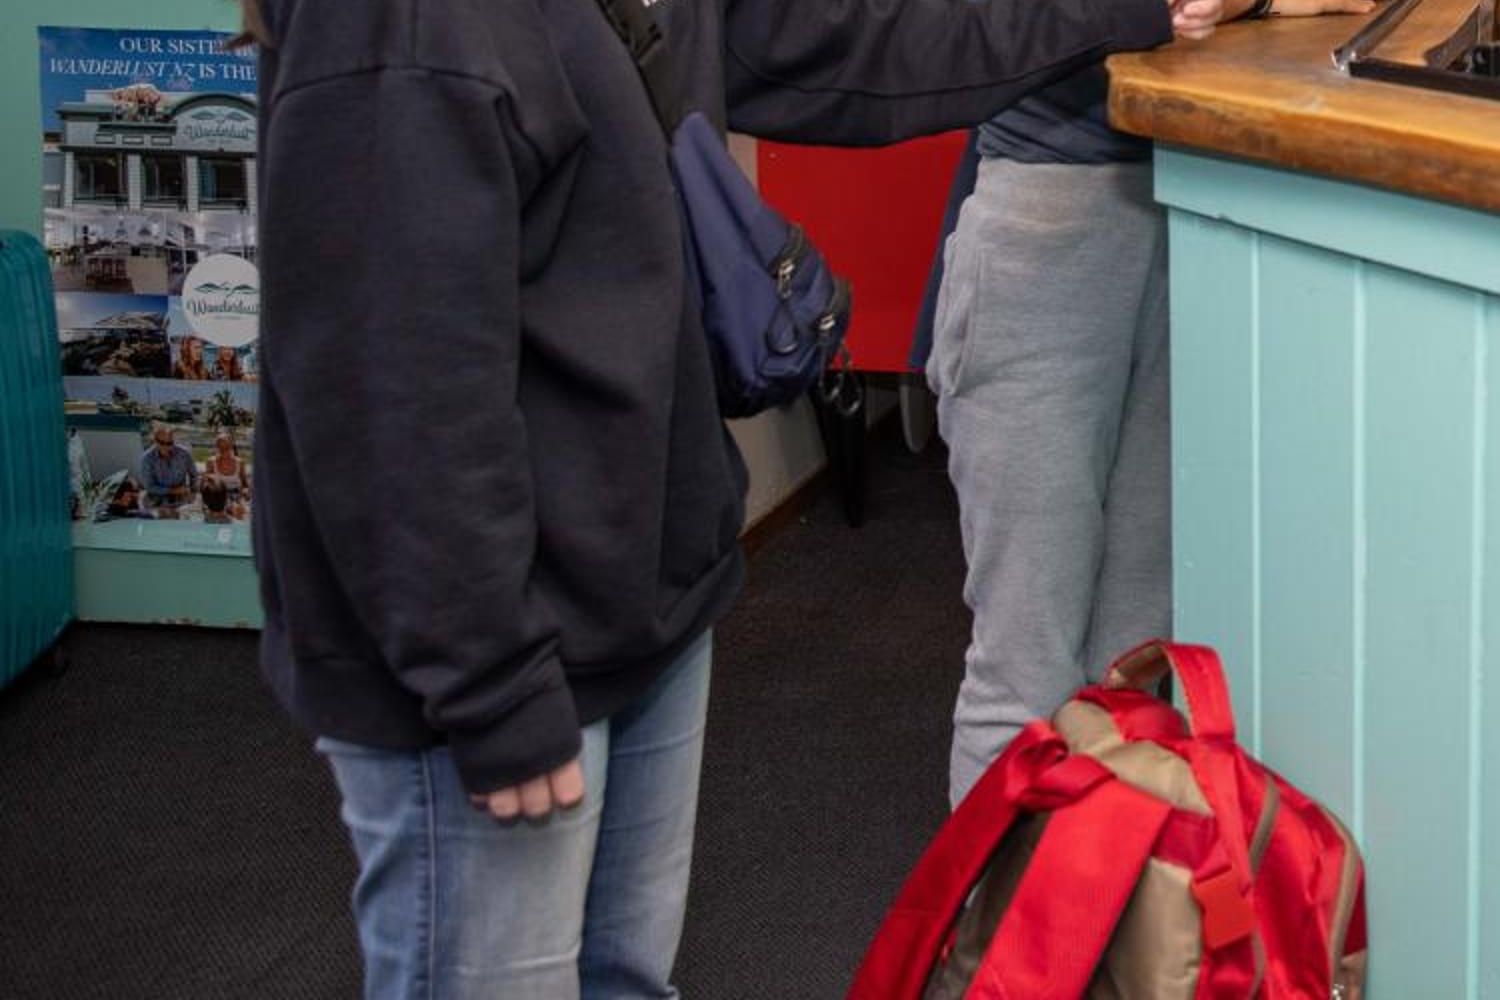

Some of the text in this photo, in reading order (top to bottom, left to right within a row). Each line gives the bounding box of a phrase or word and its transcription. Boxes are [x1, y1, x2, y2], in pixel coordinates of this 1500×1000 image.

[119, 37, 161, 53] OUR
[50, 58, 257, 82] WANDERLUST NZ IS THE
